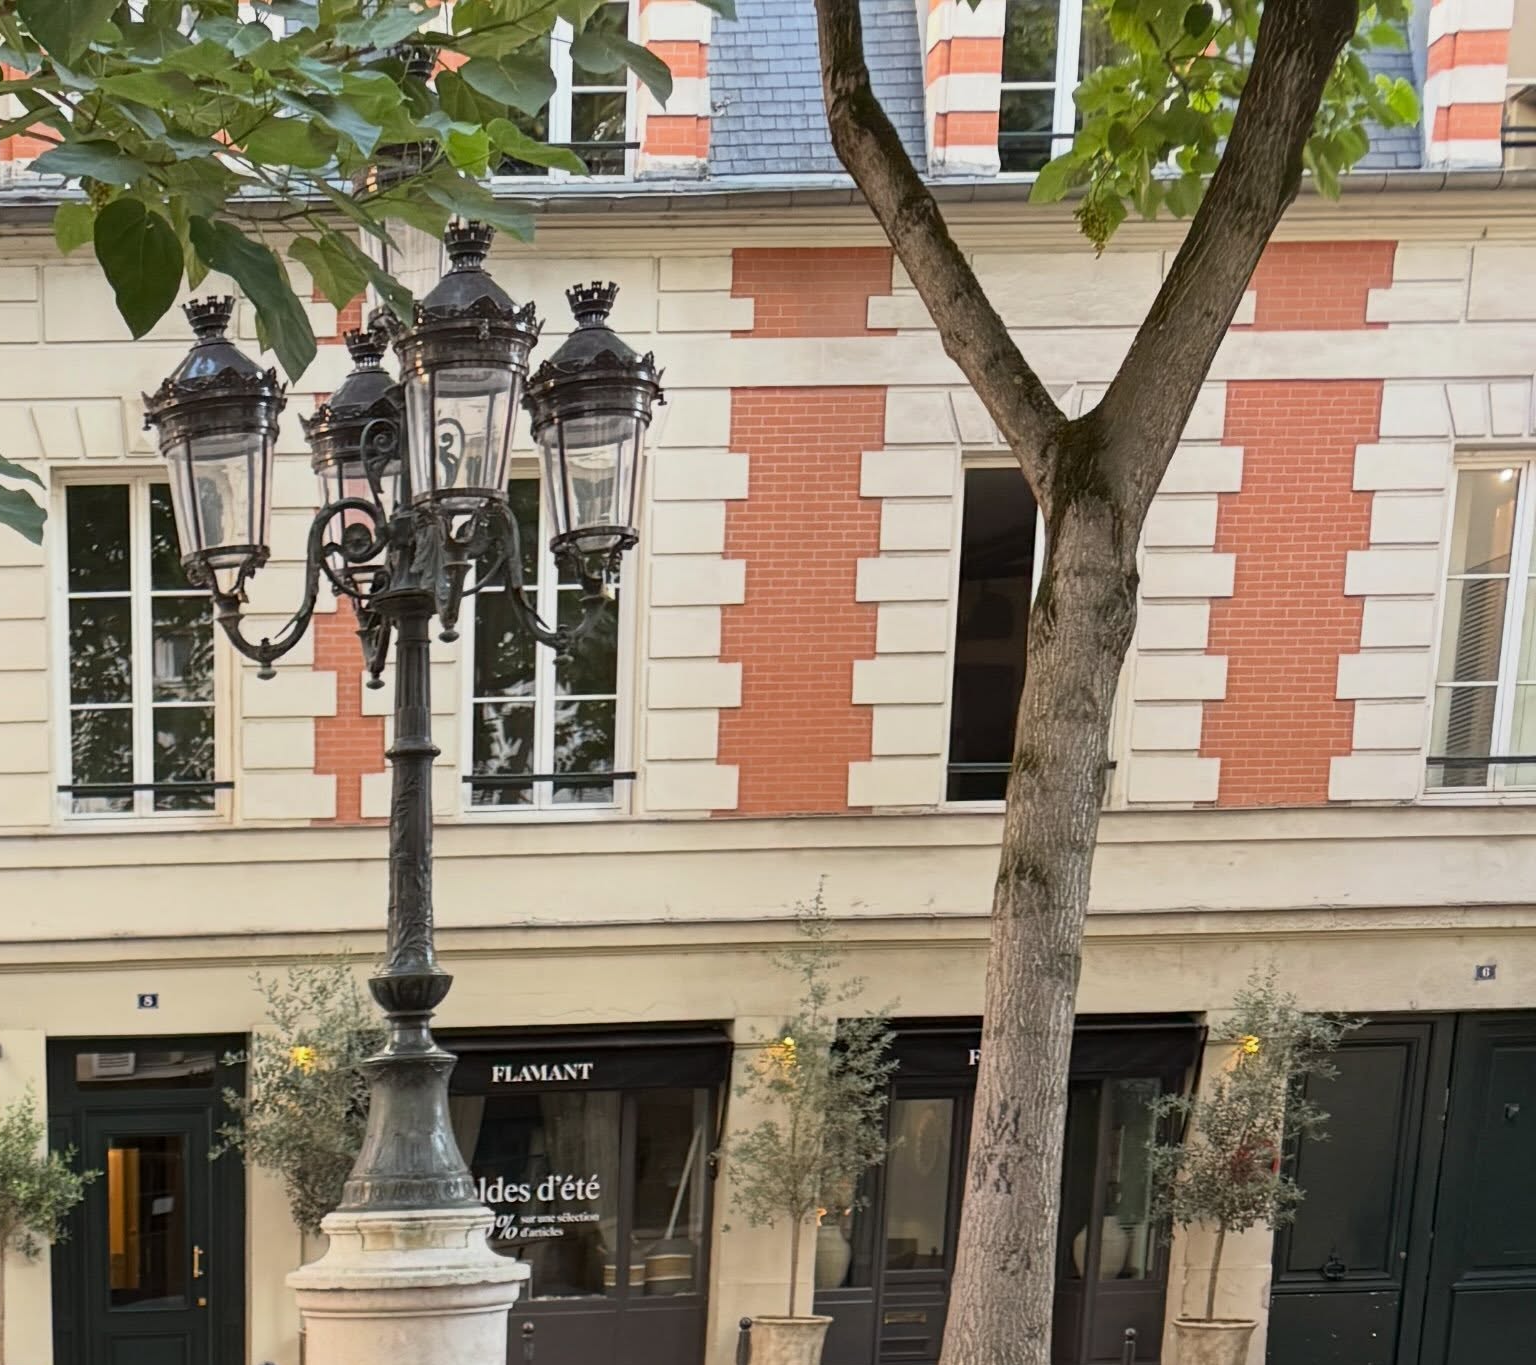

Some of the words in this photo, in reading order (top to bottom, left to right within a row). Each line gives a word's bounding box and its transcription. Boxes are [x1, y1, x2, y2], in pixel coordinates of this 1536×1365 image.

[492, 1062, 594, 1083] FLAMANT
[473, 1175, 531, 1204] ldes
[537, 1173, 601, 1202] d'été
